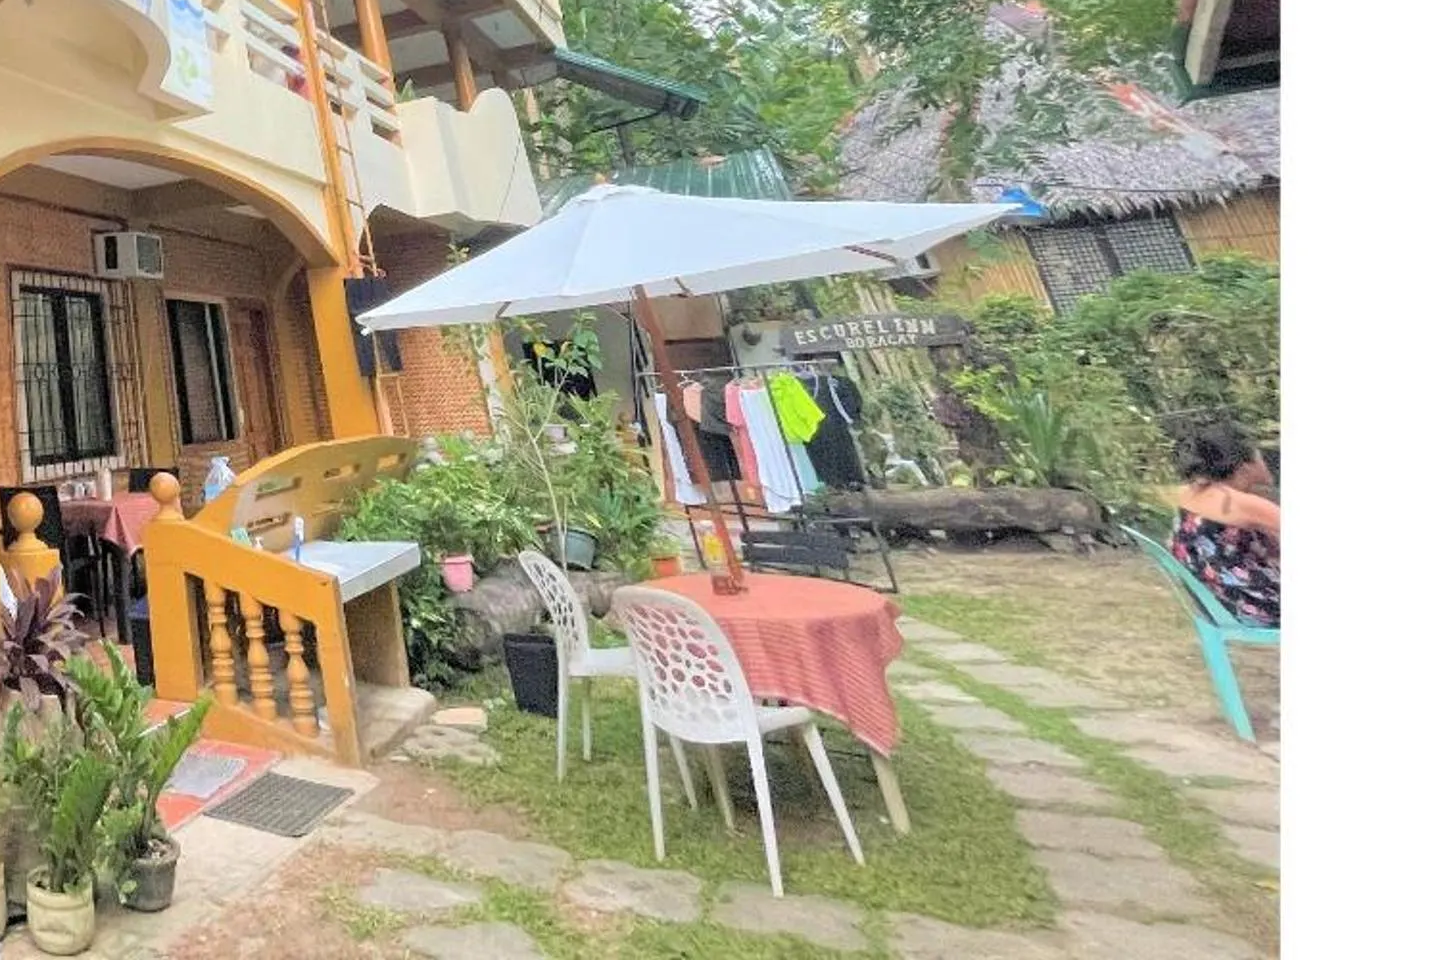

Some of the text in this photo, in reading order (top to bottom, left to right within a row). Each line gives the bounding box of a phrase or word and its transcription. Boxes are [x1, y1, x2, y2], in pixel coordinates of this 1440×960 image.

[794, 318, 936, 345] ESCUREL INN
[846, 334, 917, 348] BORACAY
